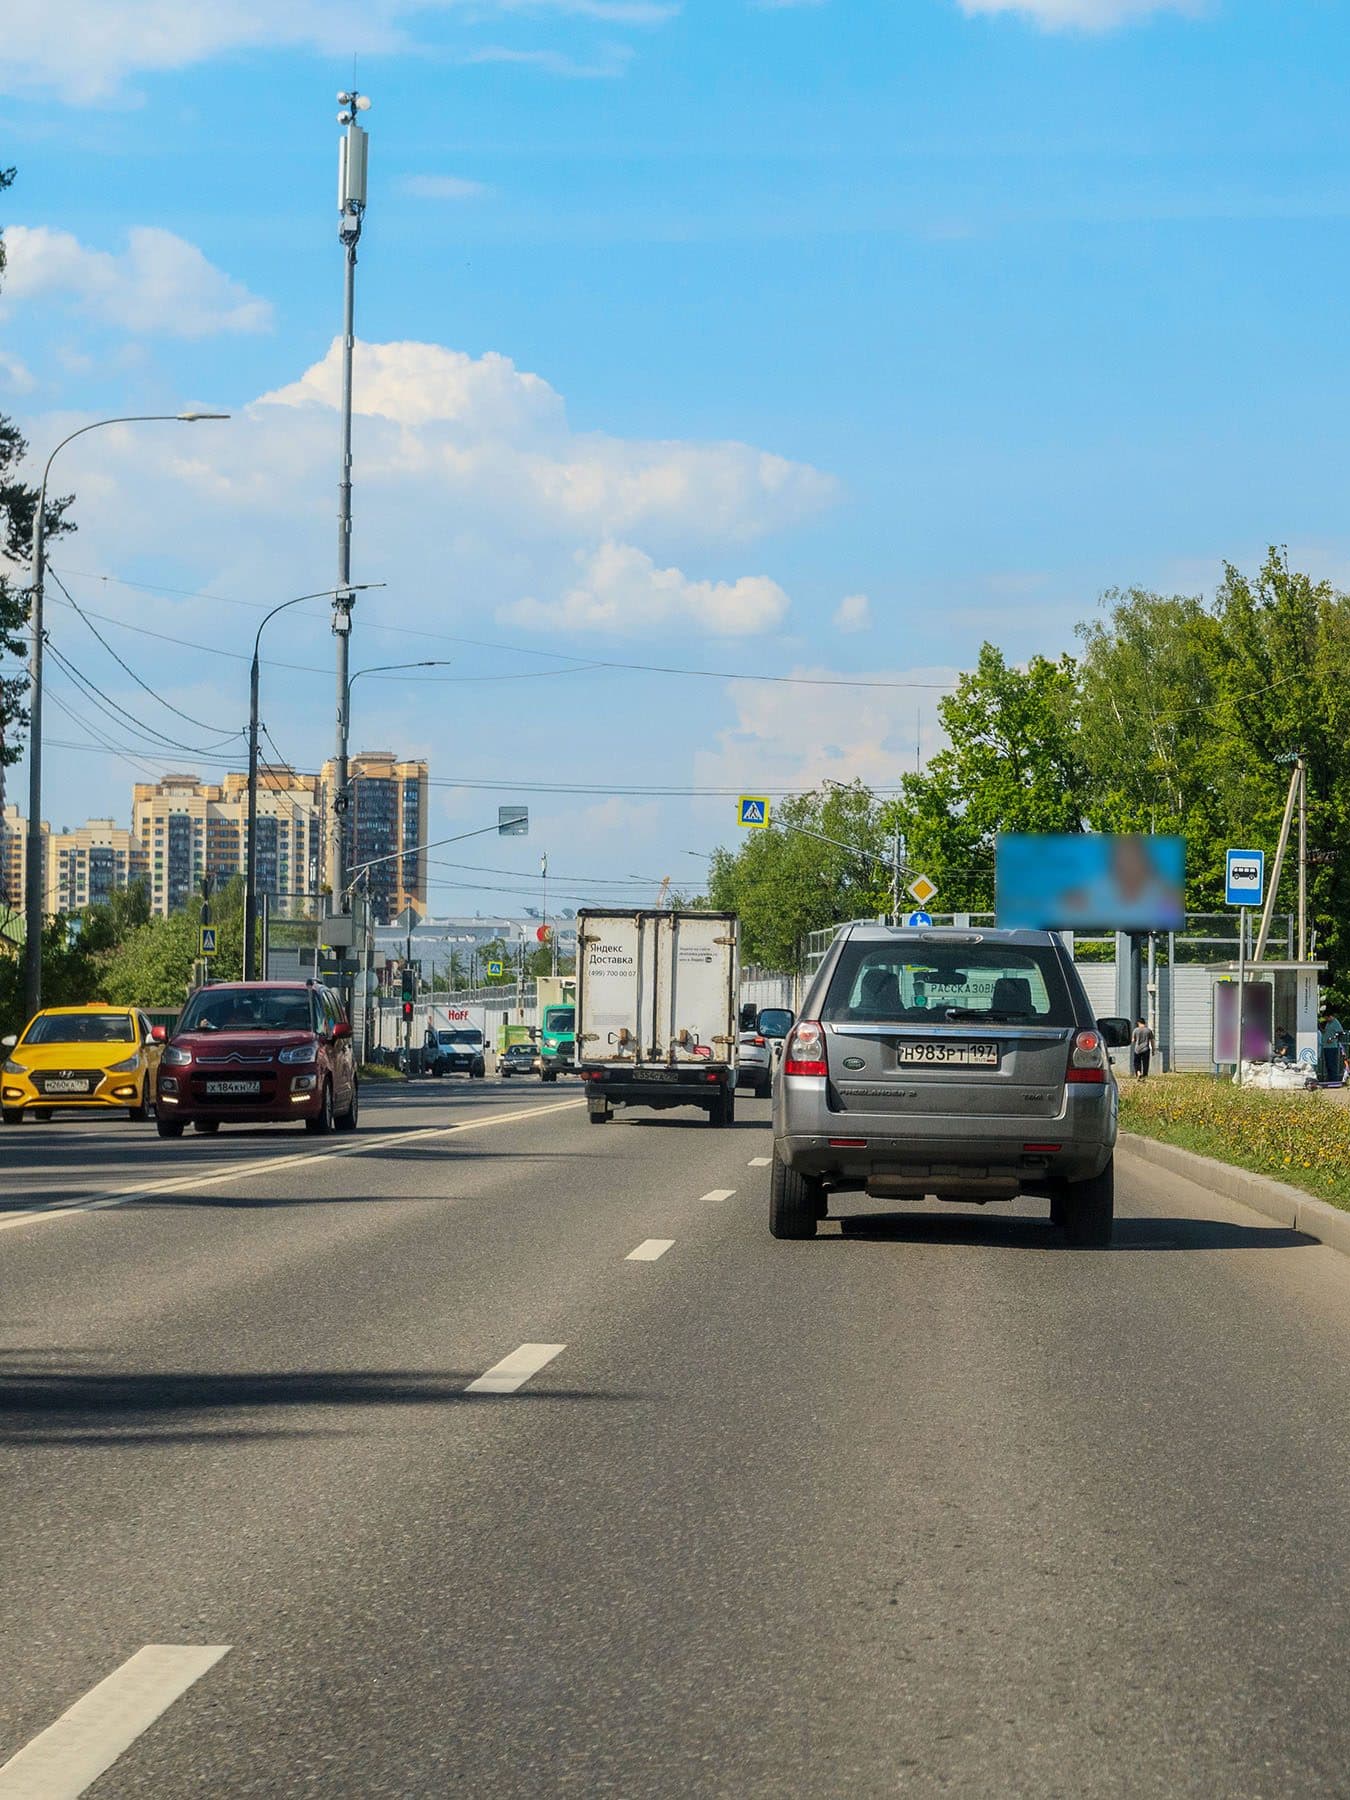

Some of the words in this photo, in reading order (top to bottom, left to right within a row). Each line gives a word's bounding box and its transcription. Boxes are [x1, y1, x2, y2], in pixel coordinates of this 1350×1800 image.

[590, 943, 623, 953] Яндекс
[590, 954, 633, 965] Доставка
[970, 1045, 993, 1057] 197
